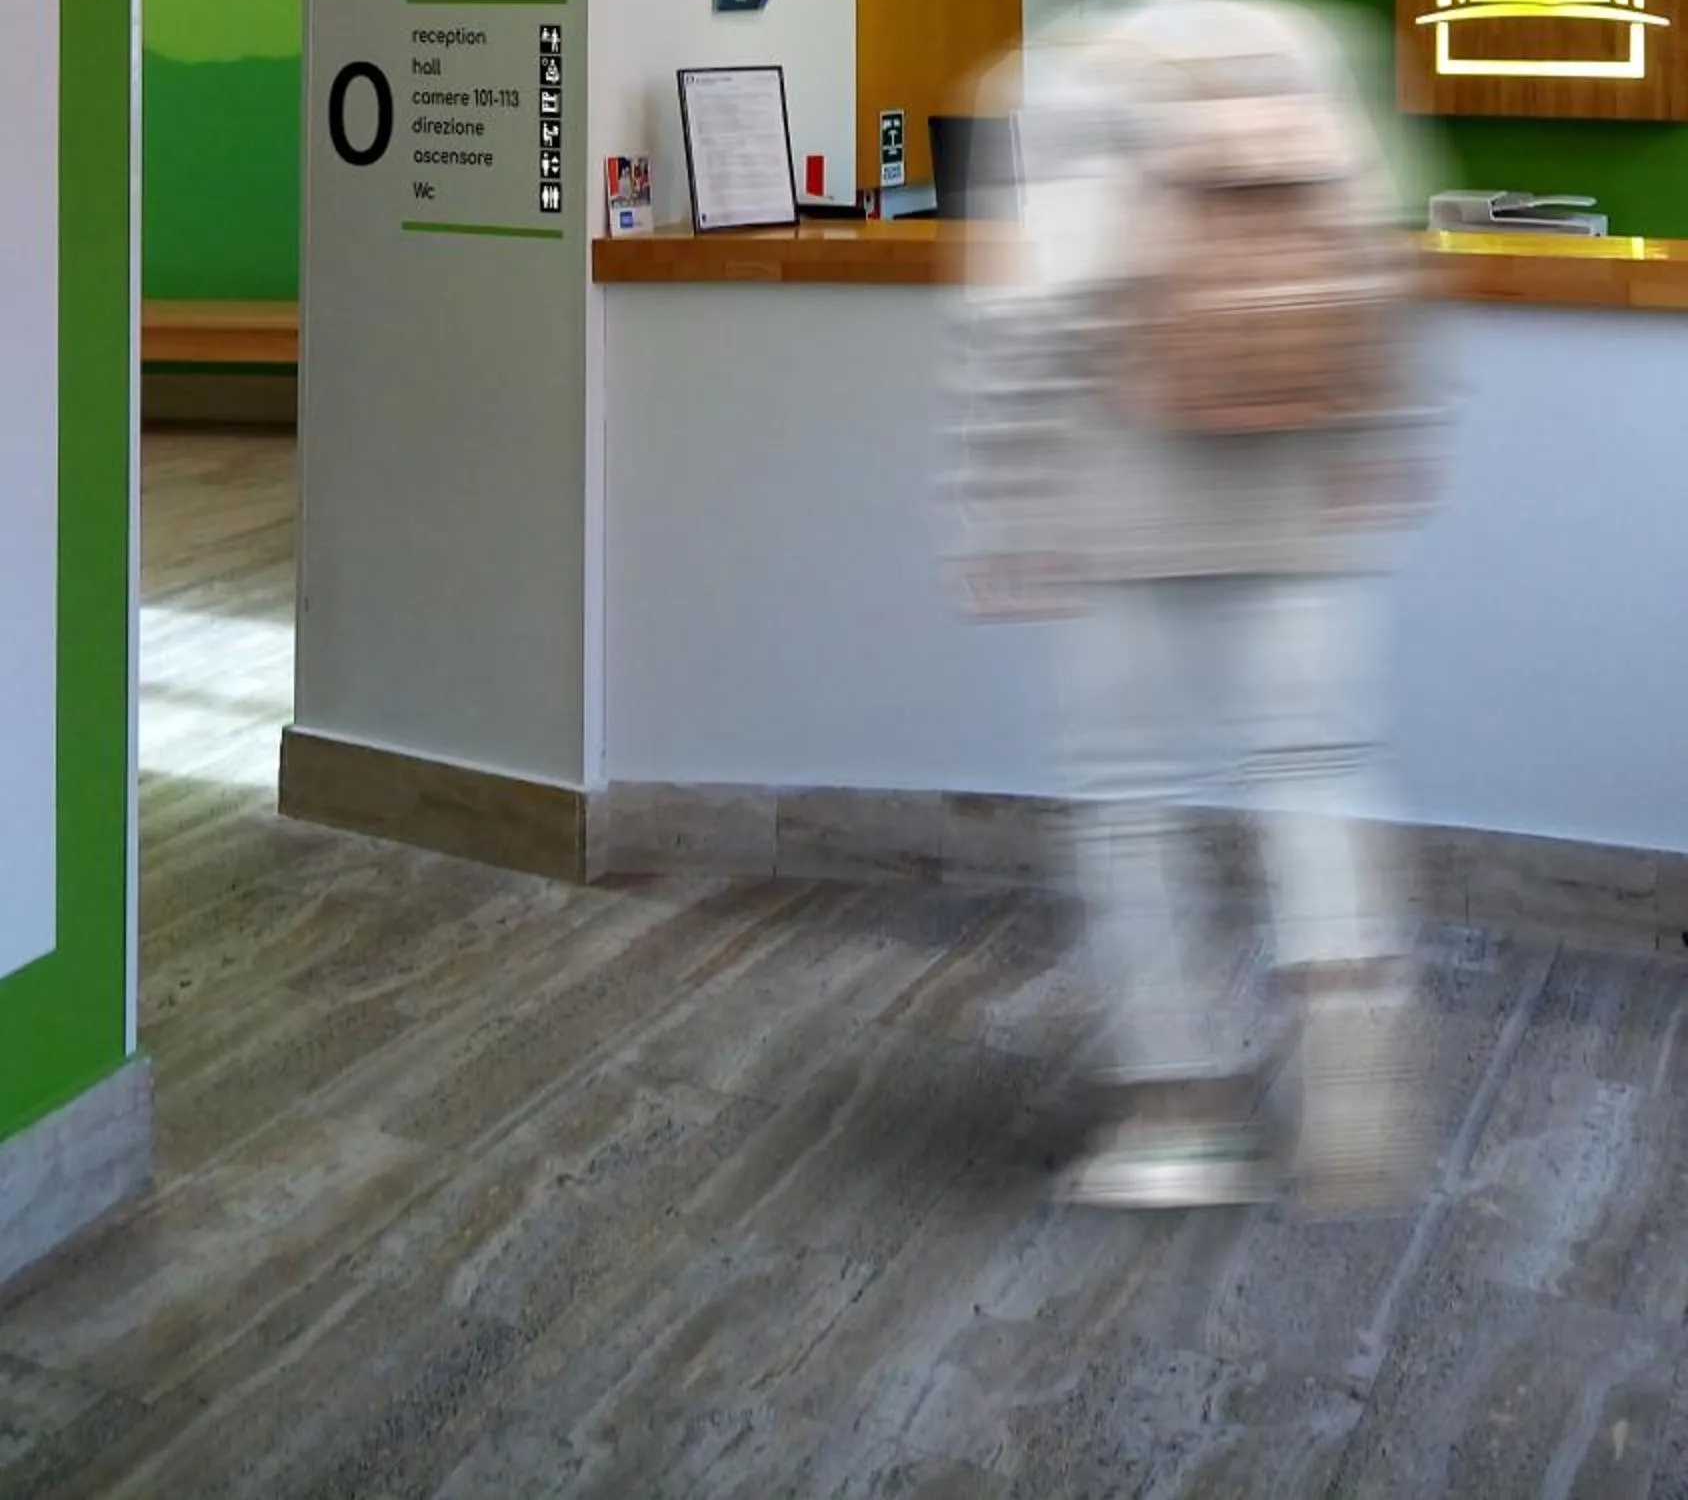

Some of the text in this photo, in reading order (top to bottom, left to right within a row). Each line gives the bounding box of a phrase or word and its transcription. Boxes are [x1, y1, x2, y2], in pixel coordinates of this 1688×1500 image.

[412, 27, 487, 48] reception
[412, 57, 442, 76] hall
[412, 88, 520, 108] camere 101-113
[412, 116, 485, 136] direzione
[413, 148, 494, 167] ascensore
[413, 181, 436, 200] Wc
